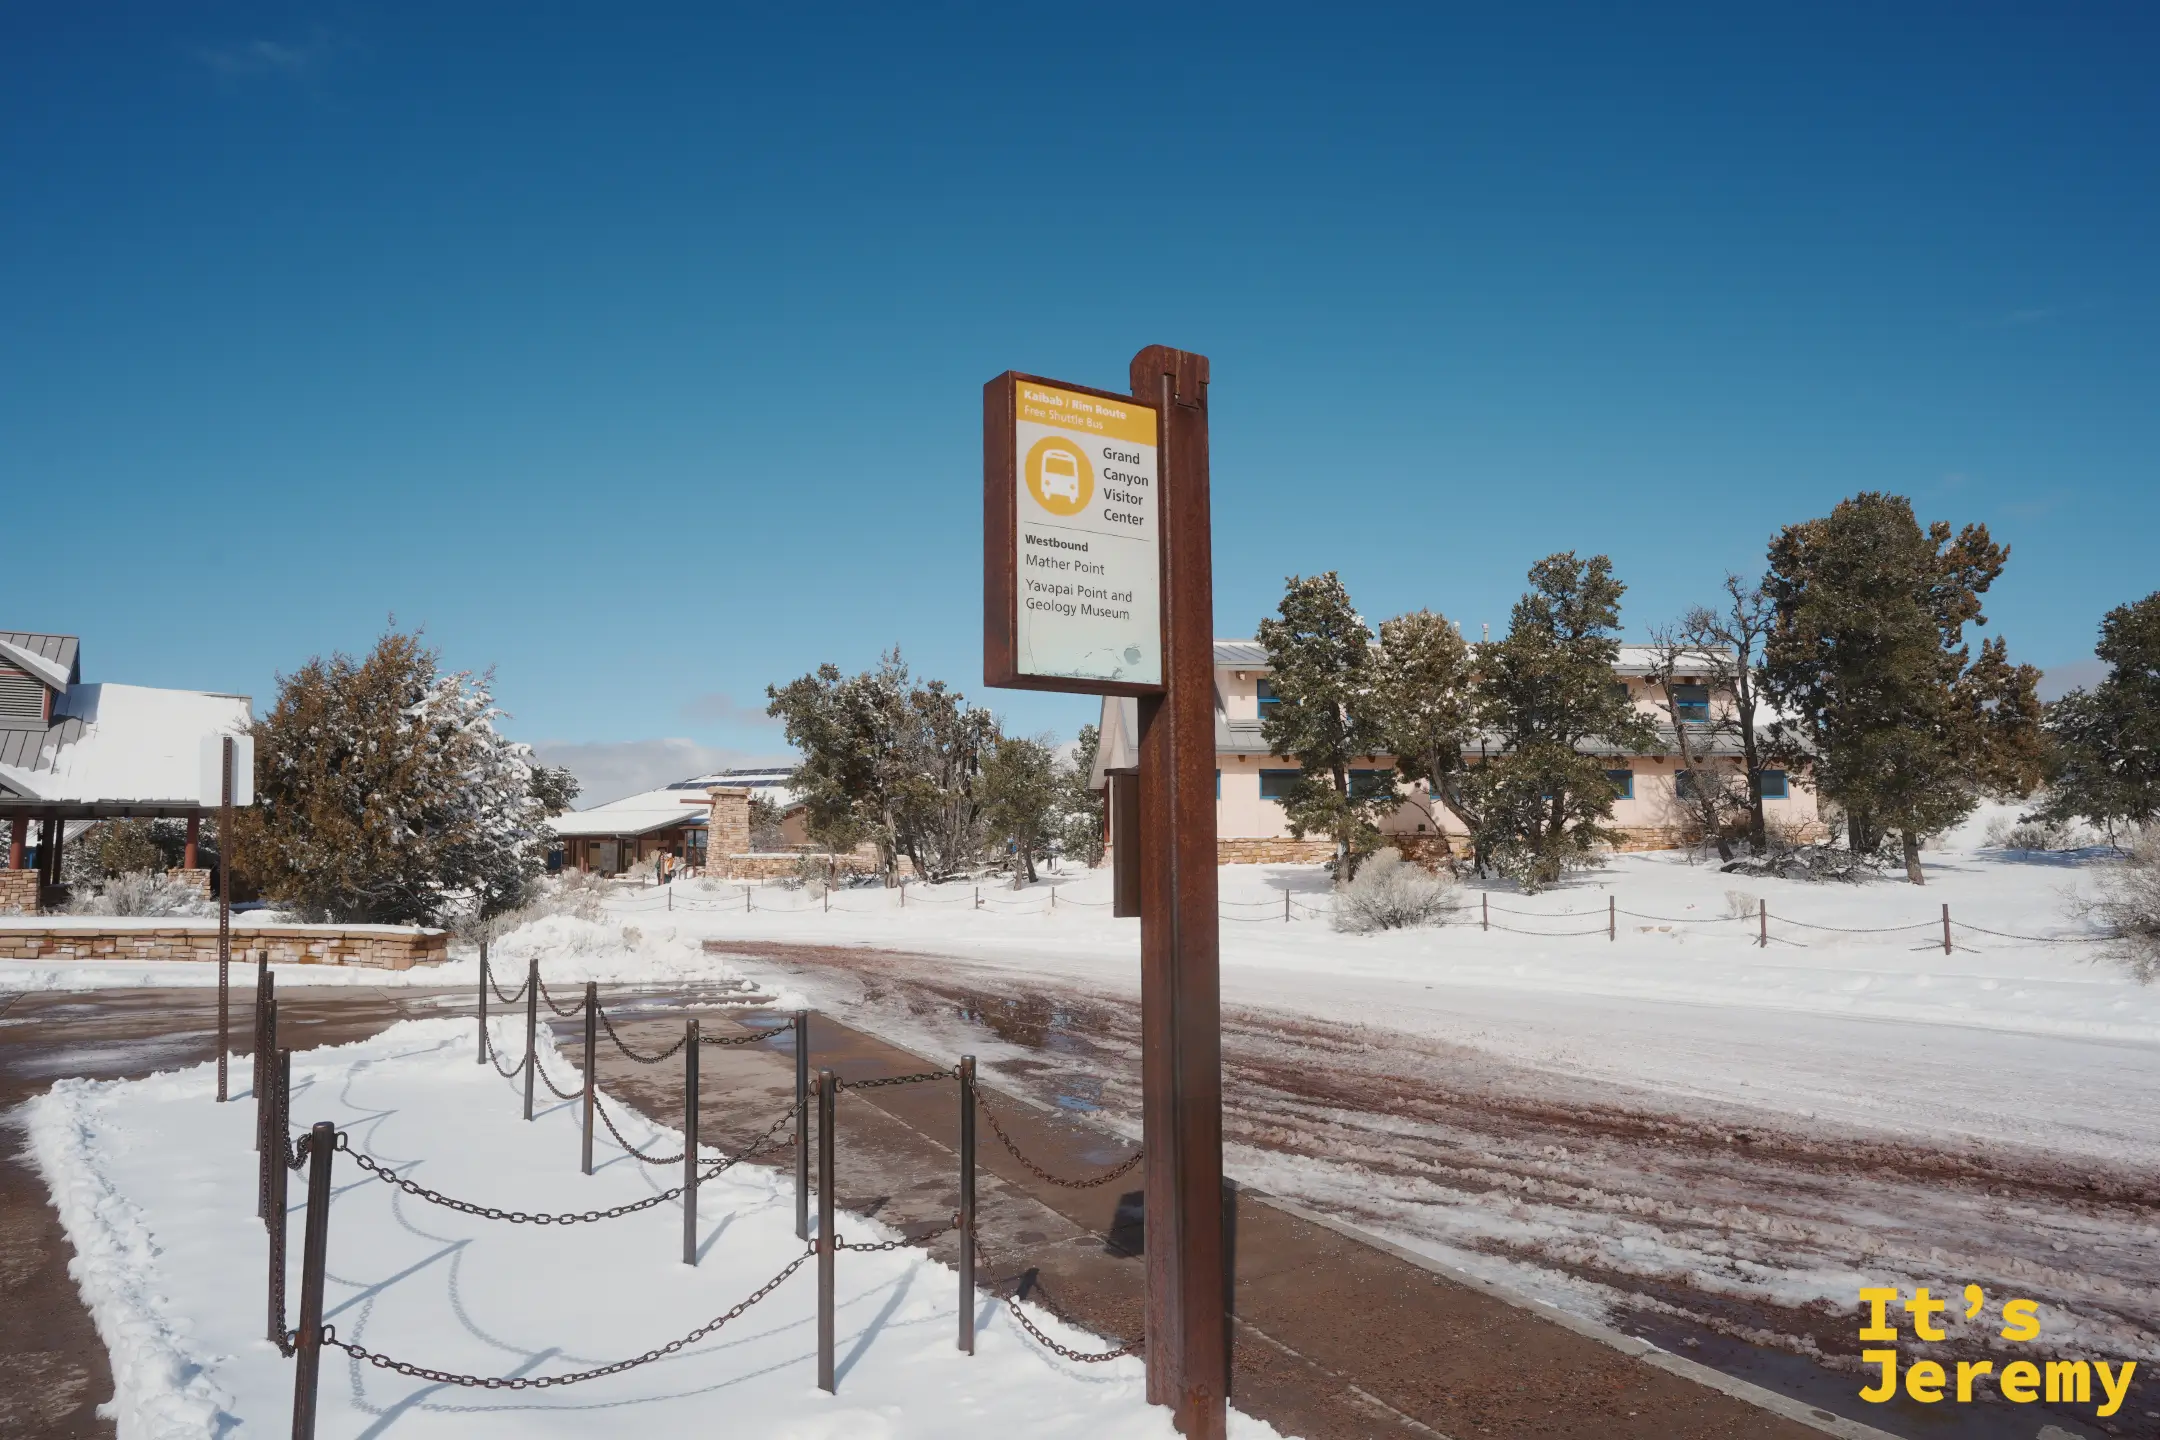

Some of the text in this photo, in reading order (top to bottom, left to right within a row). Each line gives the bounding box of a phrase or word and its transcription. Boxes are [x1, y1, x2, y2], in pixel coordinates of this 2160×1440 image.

[1024, 389, 1063, 407] Kaibab
[1072, 399, 1093, 412] Rim
[1096, 404, 1127, 420] Route
[1024, 405, 1103, 430] Free Shuttle Bus
[1103, 447, 1140, 465] Grand
[1103, 468, 1149, 487] Canyon
[1103, 488, 1143, 506] Visitor
[1104, 508, 1144, 526] Center
[1025, 534, 1089, 552] Westbound
[1026, 554, 1105, 576] Mather Point
[1026, 579, 1133, 603] Yavapai Point and
[1026, 598, 1130, 620] Geology Museum
